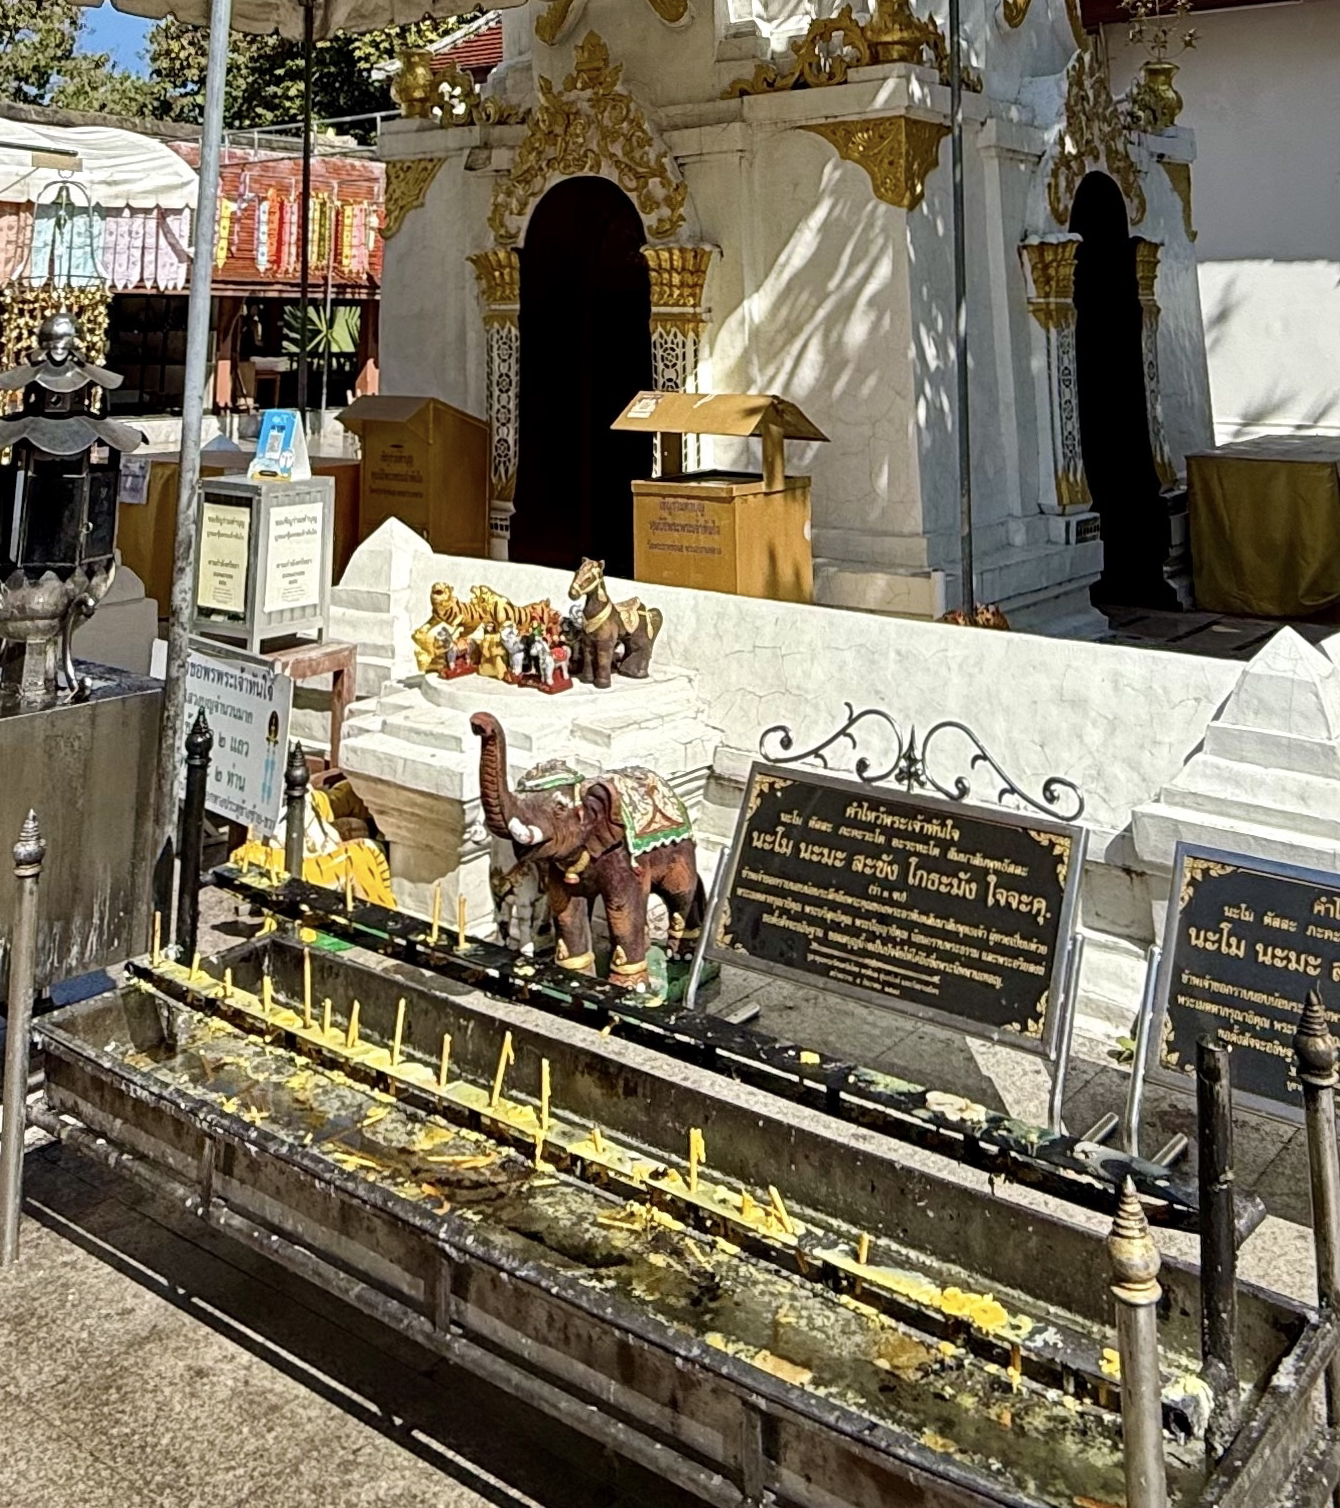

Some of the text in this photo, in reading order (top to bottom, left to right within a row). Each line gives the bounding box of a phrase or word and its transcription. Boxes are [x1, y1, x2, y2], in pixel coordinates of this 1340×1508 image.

[780, 809, 803, 825] นะโม
[845, 801, 959, 841] คำไหว้พระเจ้าทันใจ
[752, 825, 1051, 925] นะโม นะมะ สะขัง โกธะมัง ใจจะคุ.
[1223, 903, 1254, 922] นะโม
[1263, 911, 1297, 931] ตัสสะ
[1188, 921, 1245, 958] นะโม
[1255, 942, 1321, 975] นะมะ
